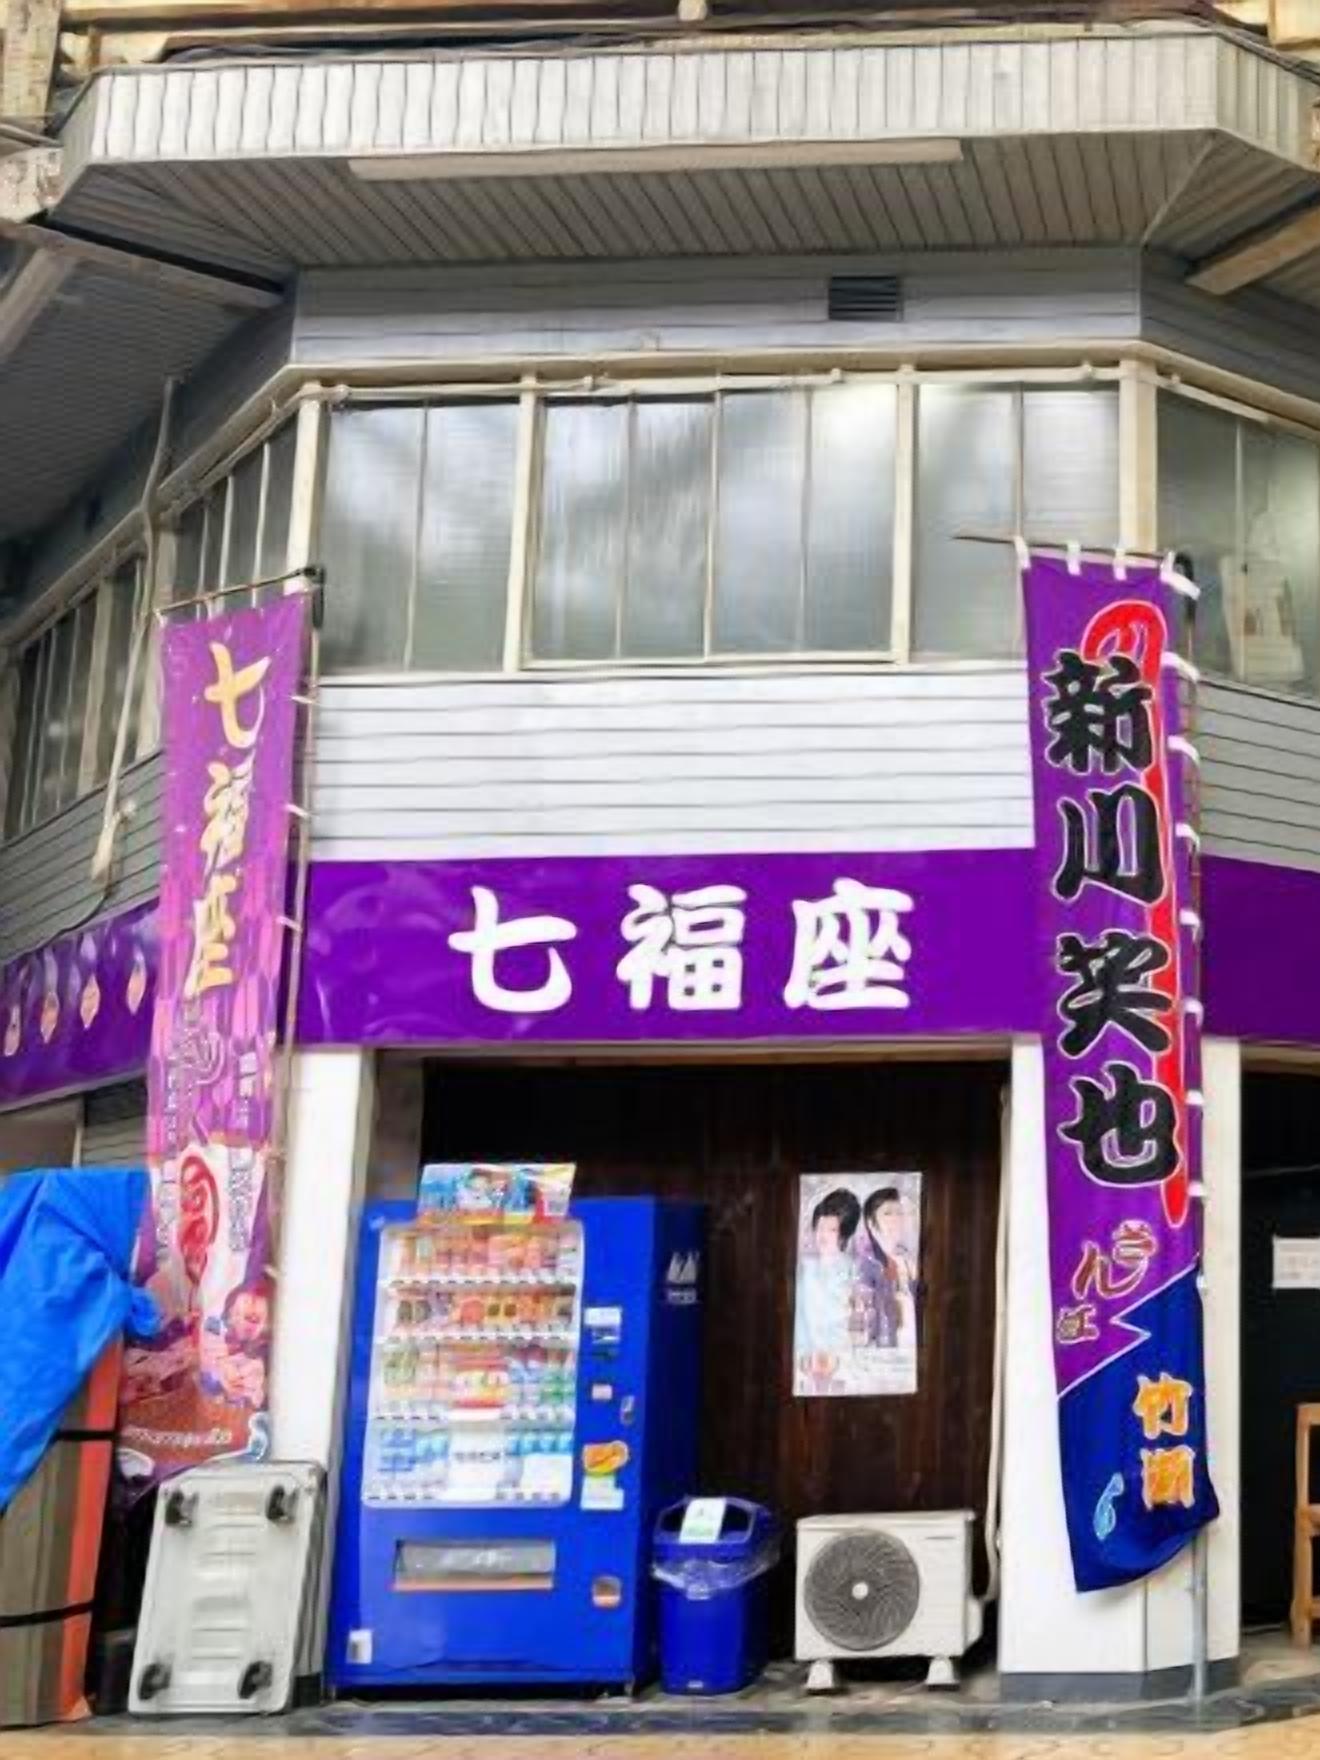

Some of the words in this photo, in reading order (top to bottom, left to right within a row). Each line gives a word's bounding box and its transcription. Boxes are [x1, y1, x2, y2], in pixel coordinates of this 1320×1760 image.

[447, 876, 916, 1013] 七福座
[1041, 648, 1181, 1188] 新川笑也
